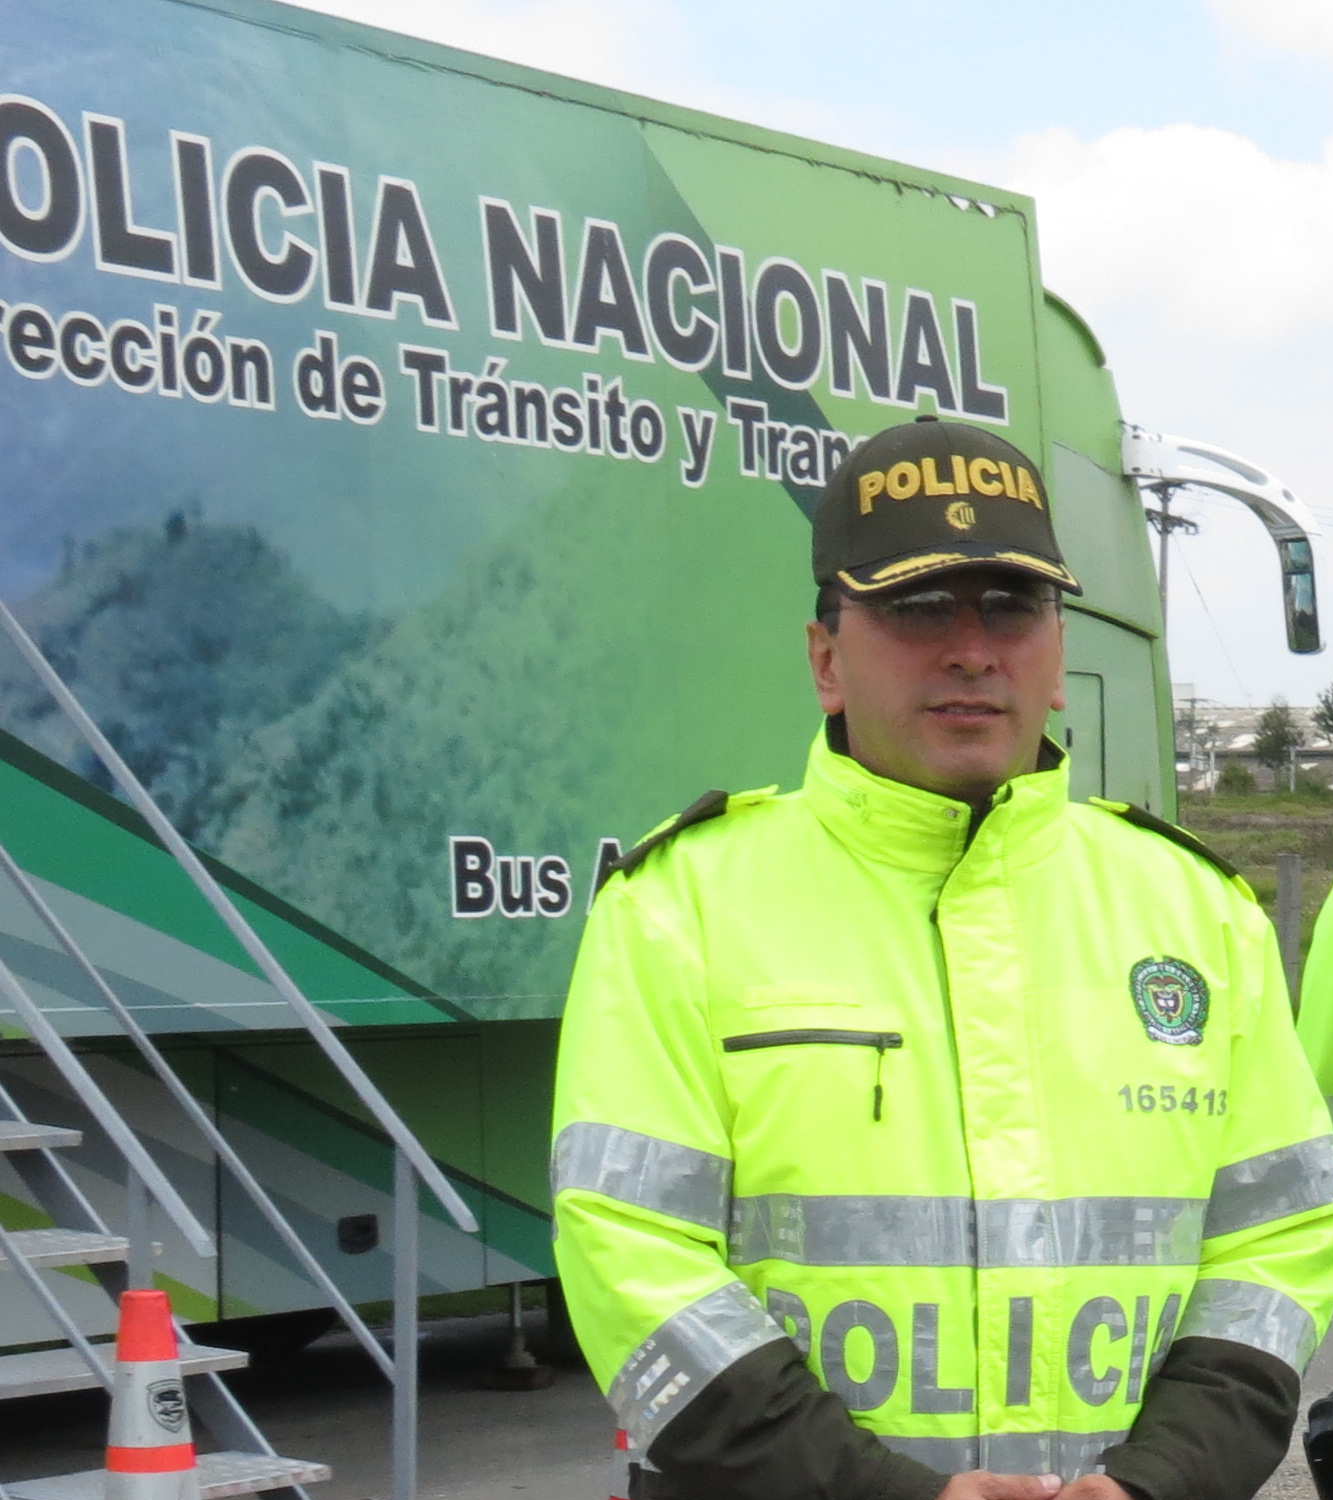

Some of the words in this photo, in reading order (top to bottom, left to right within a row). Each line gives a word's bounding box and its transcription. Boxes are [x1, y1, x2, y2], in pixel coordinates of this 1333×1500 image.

[478, 196, 1009, 426] NACIONAL
[0, 302, 276, 412] ección
[293, 329, 387, 426] de
[398, 344, 665, 463] Tránsito
[678, 405, 717, 489] y
[725, 396, 868, 487] Tran
[859, 454, 1044, 516] POLICIA
[449, 836, 571, 918] Bus
